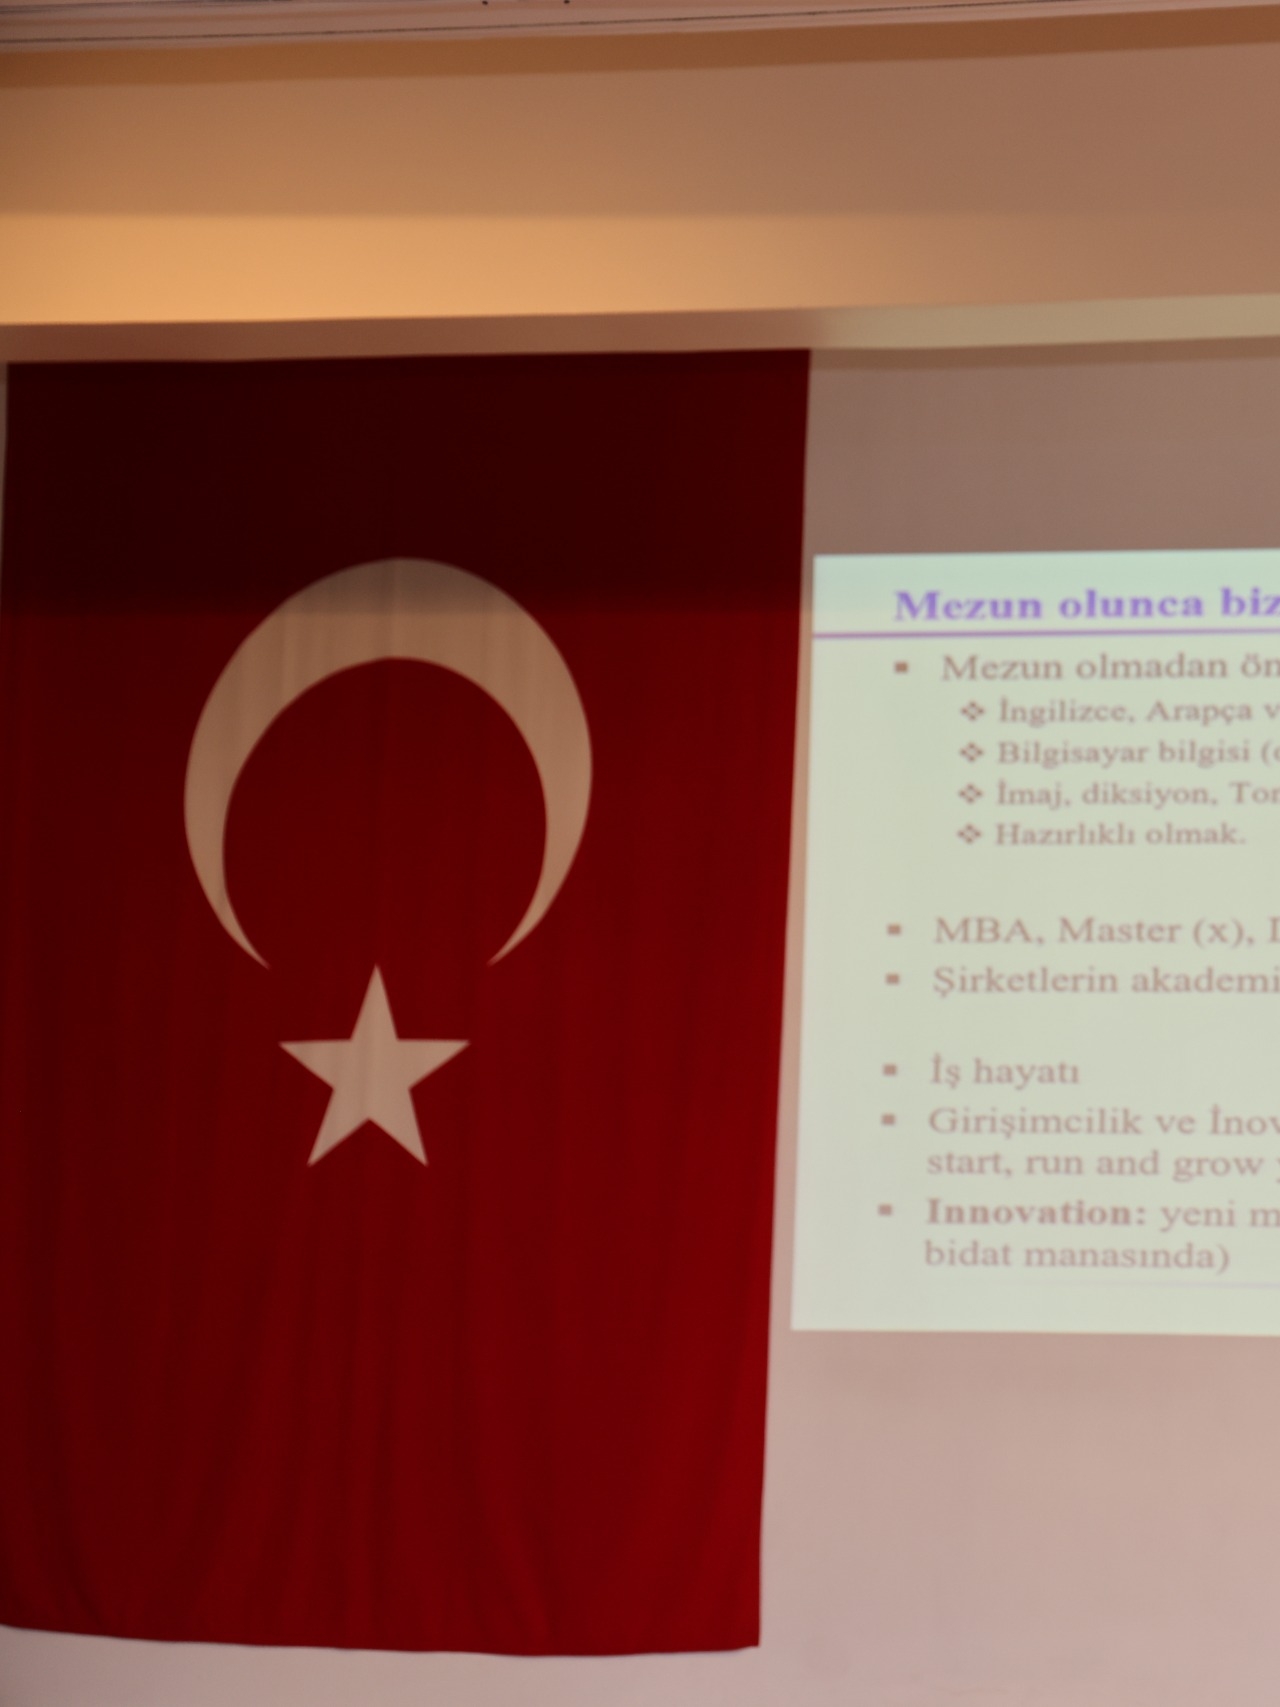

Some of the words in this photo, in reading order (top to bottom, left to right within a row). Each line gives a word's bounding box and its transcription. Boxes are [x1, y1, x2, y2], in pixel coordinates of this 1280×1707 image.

[896, 591, 1042, 620] Mezun
[1058, 589, 1204, 618] olunca
[942, 655, 1063, 681] Mezun
[1075, 652, 1228, 680] olmadan
[999, 695, 1136, 729] İngilizce,
[1146, 700, 1253, 727] Arapça
[998, 740, 1149, 770] Bilgisayar
[1158, 739, 1250, 769] bilgisi
[997, 778, 1071, 811] İmaj,
[1082, 782, 1218, 810] diksiyon,
[995, 822, 1135, 846] Hazırlıklı
[1145, 822, 1246, 845] olmak.
[935, 916, 1045, 945] MBA,
[1058, 916, 1182, 943] Master
[1192, 919, 1255, 948] (x),
[933, 966, 1118, 998] Şirketlerin
[1131, 966, 1280, 994] akademi
[931, 1052, 961, 1089] İş
[973, 1057, 1079, 1091] hayatı
[928, 1107, 1143, 1140] Girişimcilik
[1155, 1115, 1196, 1135] ve
[927, 1152, 1013, 1178] start,
[1026, 1155, 1084, 1175] run
[1096, 1149, 1160, 1176] and
[1172, 1157, 1265, 1183] grow
[927, 1198, 1145, 1226] Innovation:
[1160, 1200, 1236, 1233] yeni
[924, 1239, 1012, 1267] bidat
[1024, 1242, 1230, 1274] manasında)
